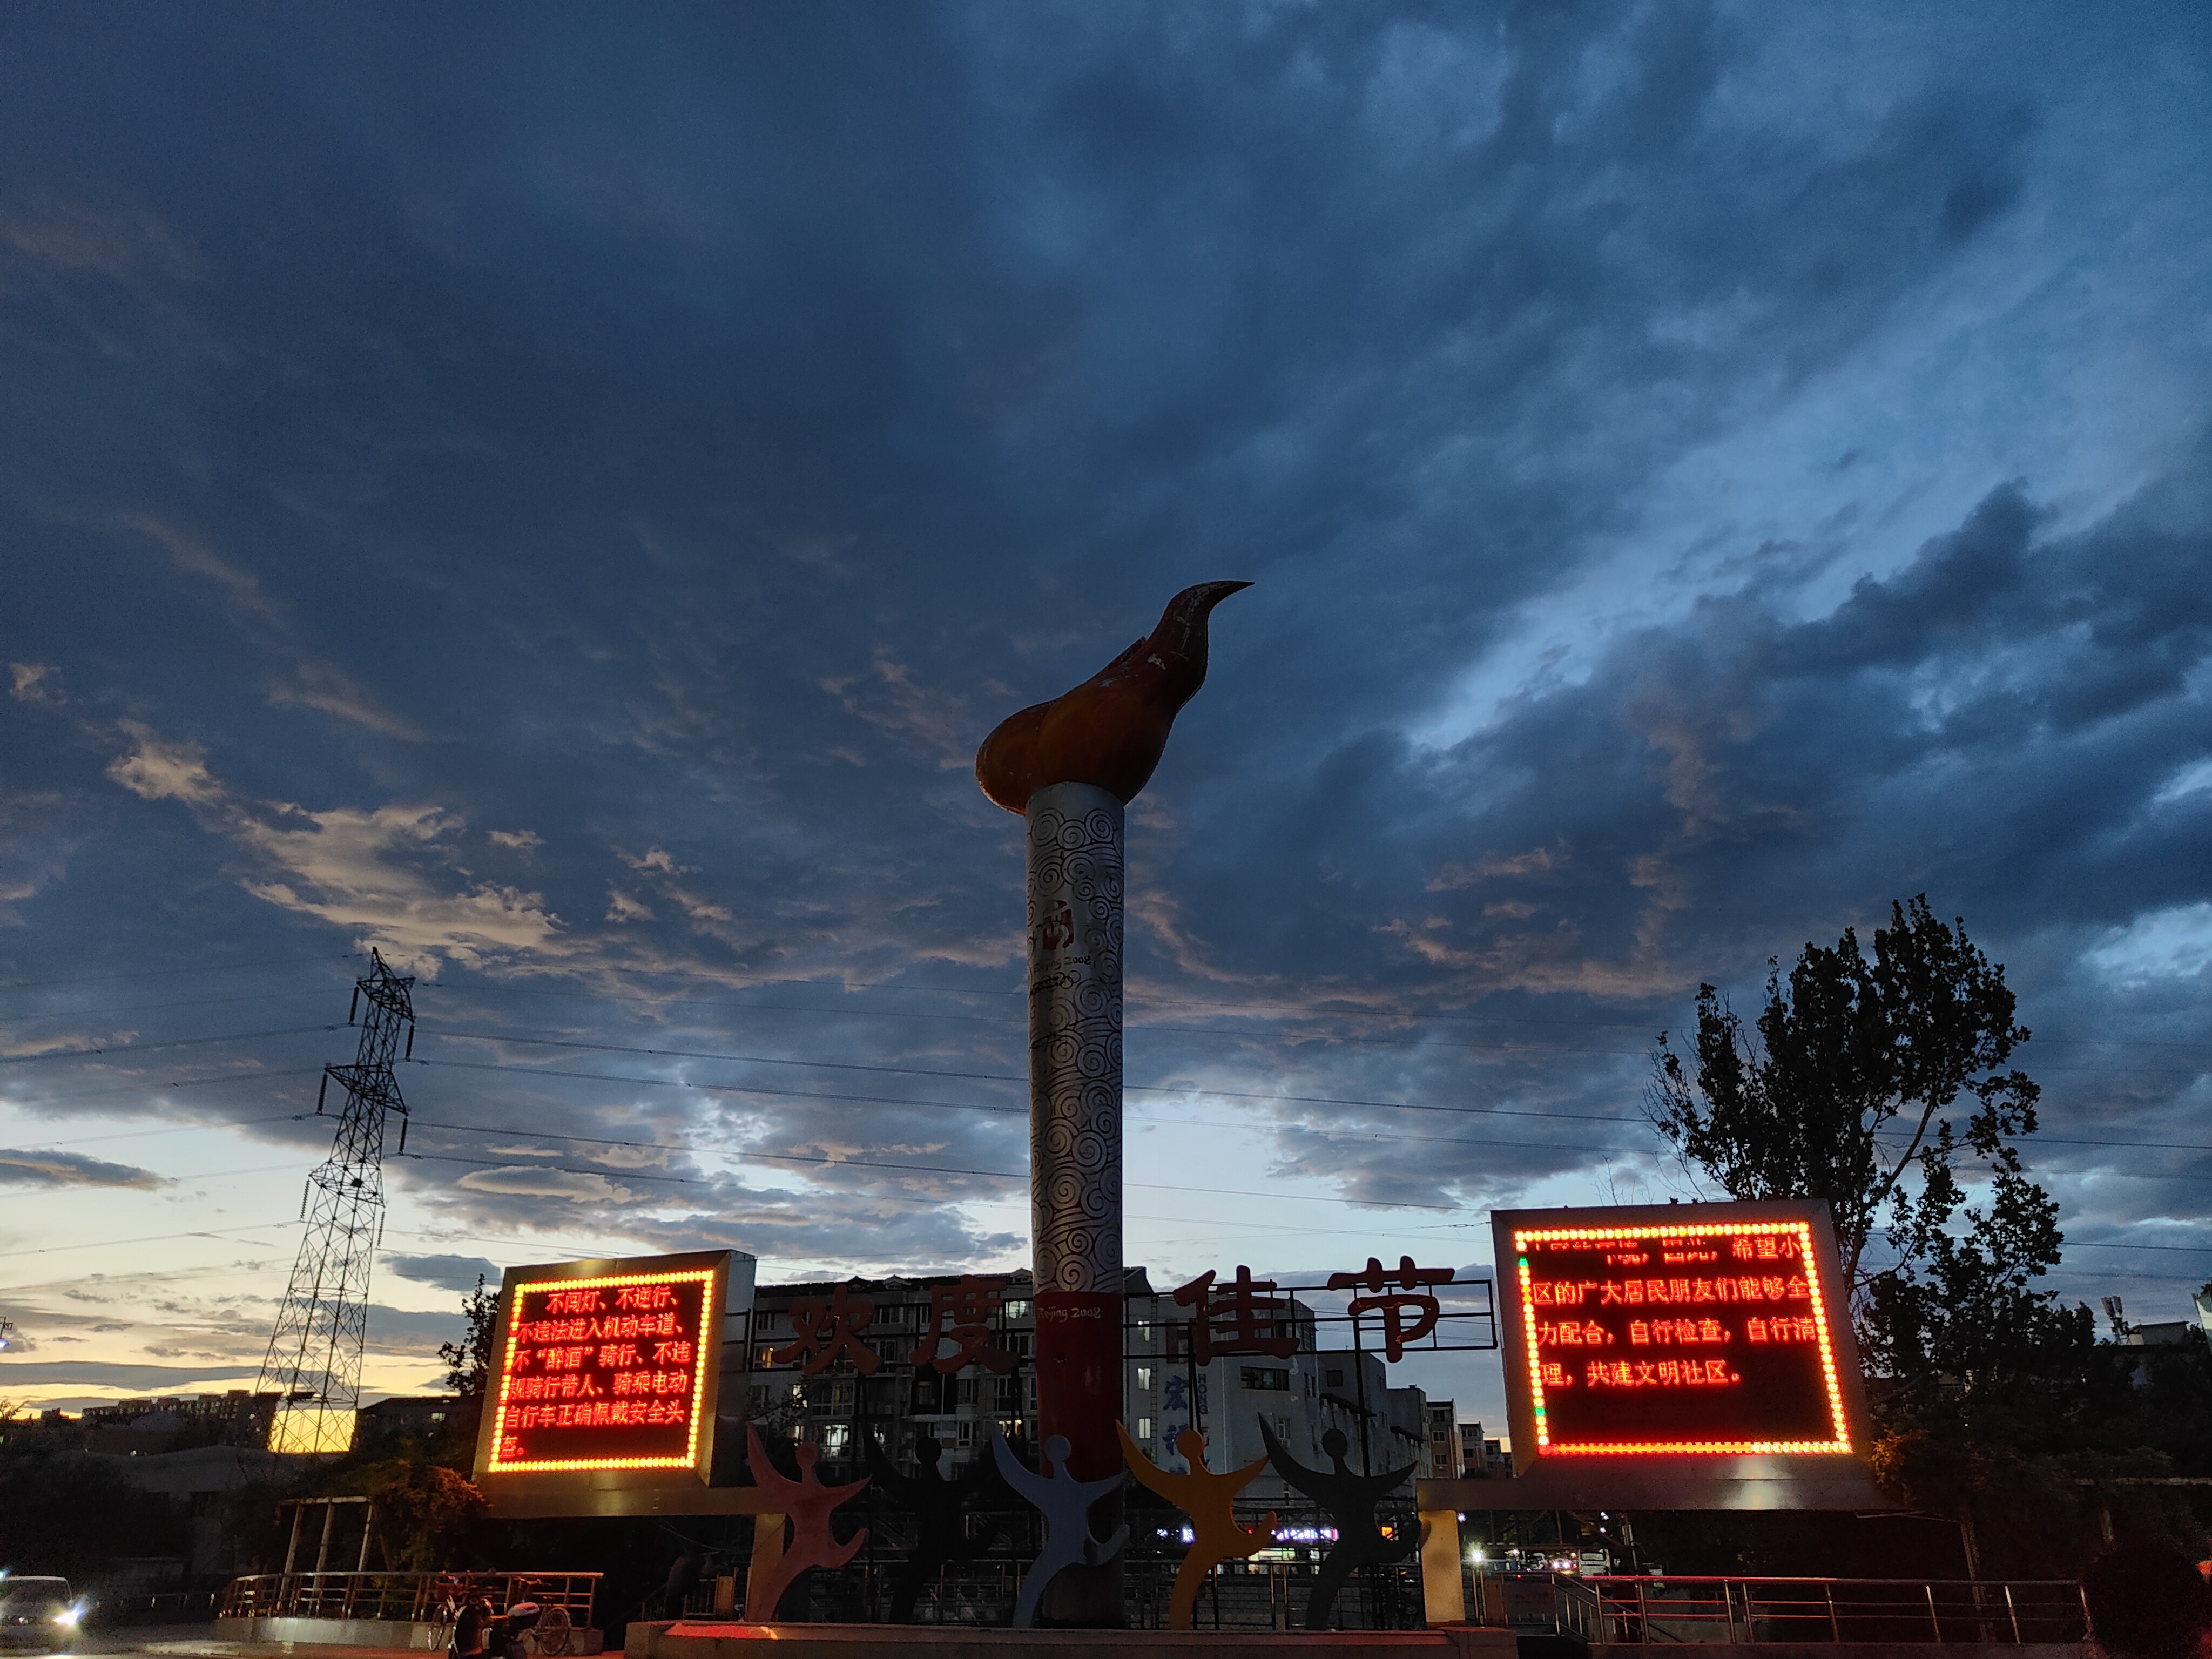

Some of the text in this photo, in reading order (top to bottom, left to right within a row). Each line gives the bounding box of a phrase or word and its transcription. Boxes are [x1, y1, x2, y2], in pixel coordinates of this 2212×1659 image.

[1064, 955, 1091, 965] 2008
[1533, 1276, 1810, 1305] 区的广大居民朋友们能够全
[1036, 1306, 1101, 1323] Beijing 2008
[504, 1399, 684, 1429] 自行车正确佩戴安全头
